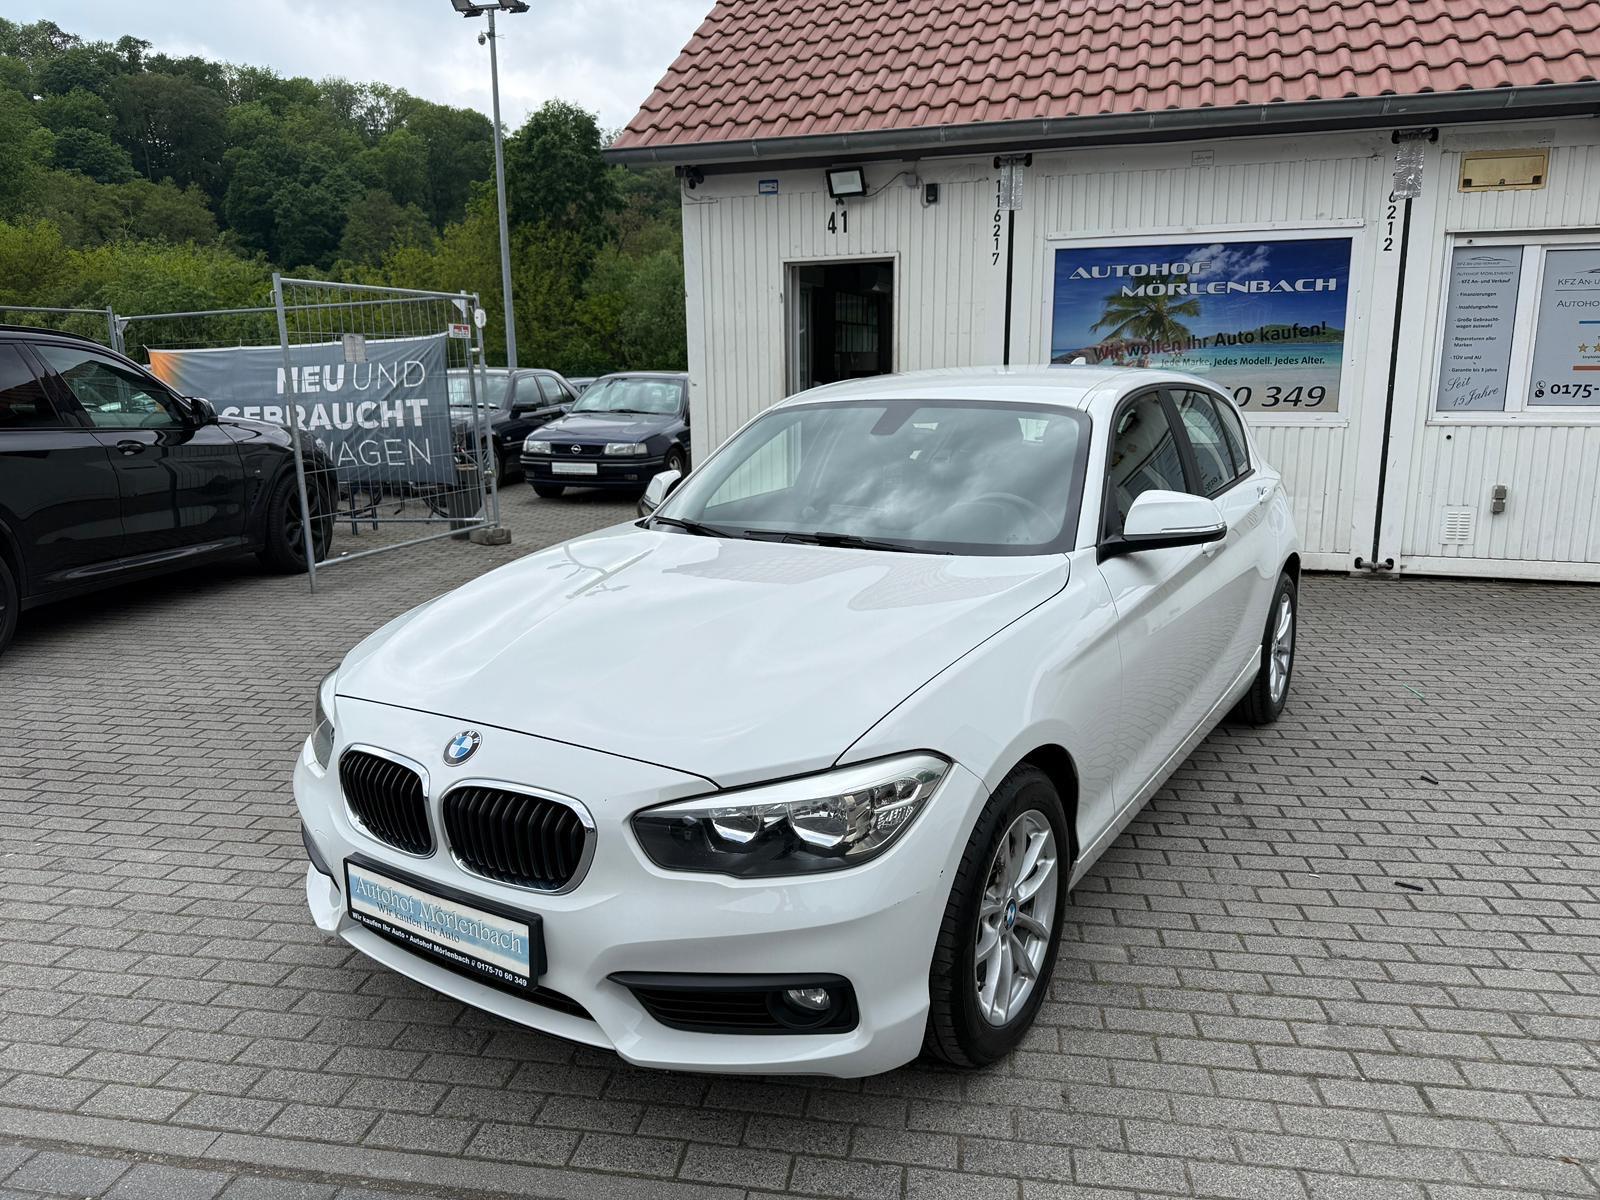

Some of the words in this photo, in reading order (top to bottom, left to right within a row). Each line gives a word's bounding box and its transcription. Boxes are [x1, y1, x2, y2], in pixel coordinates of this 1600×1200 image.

[827, 209, 849, 235] 41
[1069, 260, 1212, 280] AUTOHOF
[1120, 277, 1337, 299] MÖRLENBACH
[1557, 278, 1577, 286] KFZ
[1556, 299, 1600, 309] AUTOHO
[1126, 337, 1181, 357] wollen
[1186, 334, 1208, 350] Ihr
[1214, 331, 1254, 348] Auto
[1260, 321, 1326, 343] kaufen!
[1213, 357, 1238, 367] Jedes
[1239, 356, 1272, 365] Modell.
[1273, 356, 1299, 367] Jedes
[1300, 355, 1326, 365] Alter.
[277, 364, 345, 394] NEU
[352, 360, 426, 392] UND
[1444, 376, 1471, 393] Seit
[1225, 386, 1252, 408] 0
[1260, 385, 1327, 408] 349
[1464, 385, 1499, 407] Jahre
[329, 437, 432, 467] AGEN
[355, 875, 414, 914] Autohof
[419, 900, 522, 955] Mörlenbach
[376, 901, 393, 916] Wir
[423, 920, 438, 934] Ihr
[439, 926, 460, 943] Auto
[352, 911, 362, 921] Wir
[362, 915, 382, 929] kaufen
[382, 924, 391, 933] Ihr
[391, 927, 405, 938] Auto
[409, 935, 433, 950] Autohof
[433, 944, 470, 965] Mörlenbach
[476, 961, 503, 978] 0175-70
[504, 972, 513, 981] 60
[514, 976, 528, 987] 349
